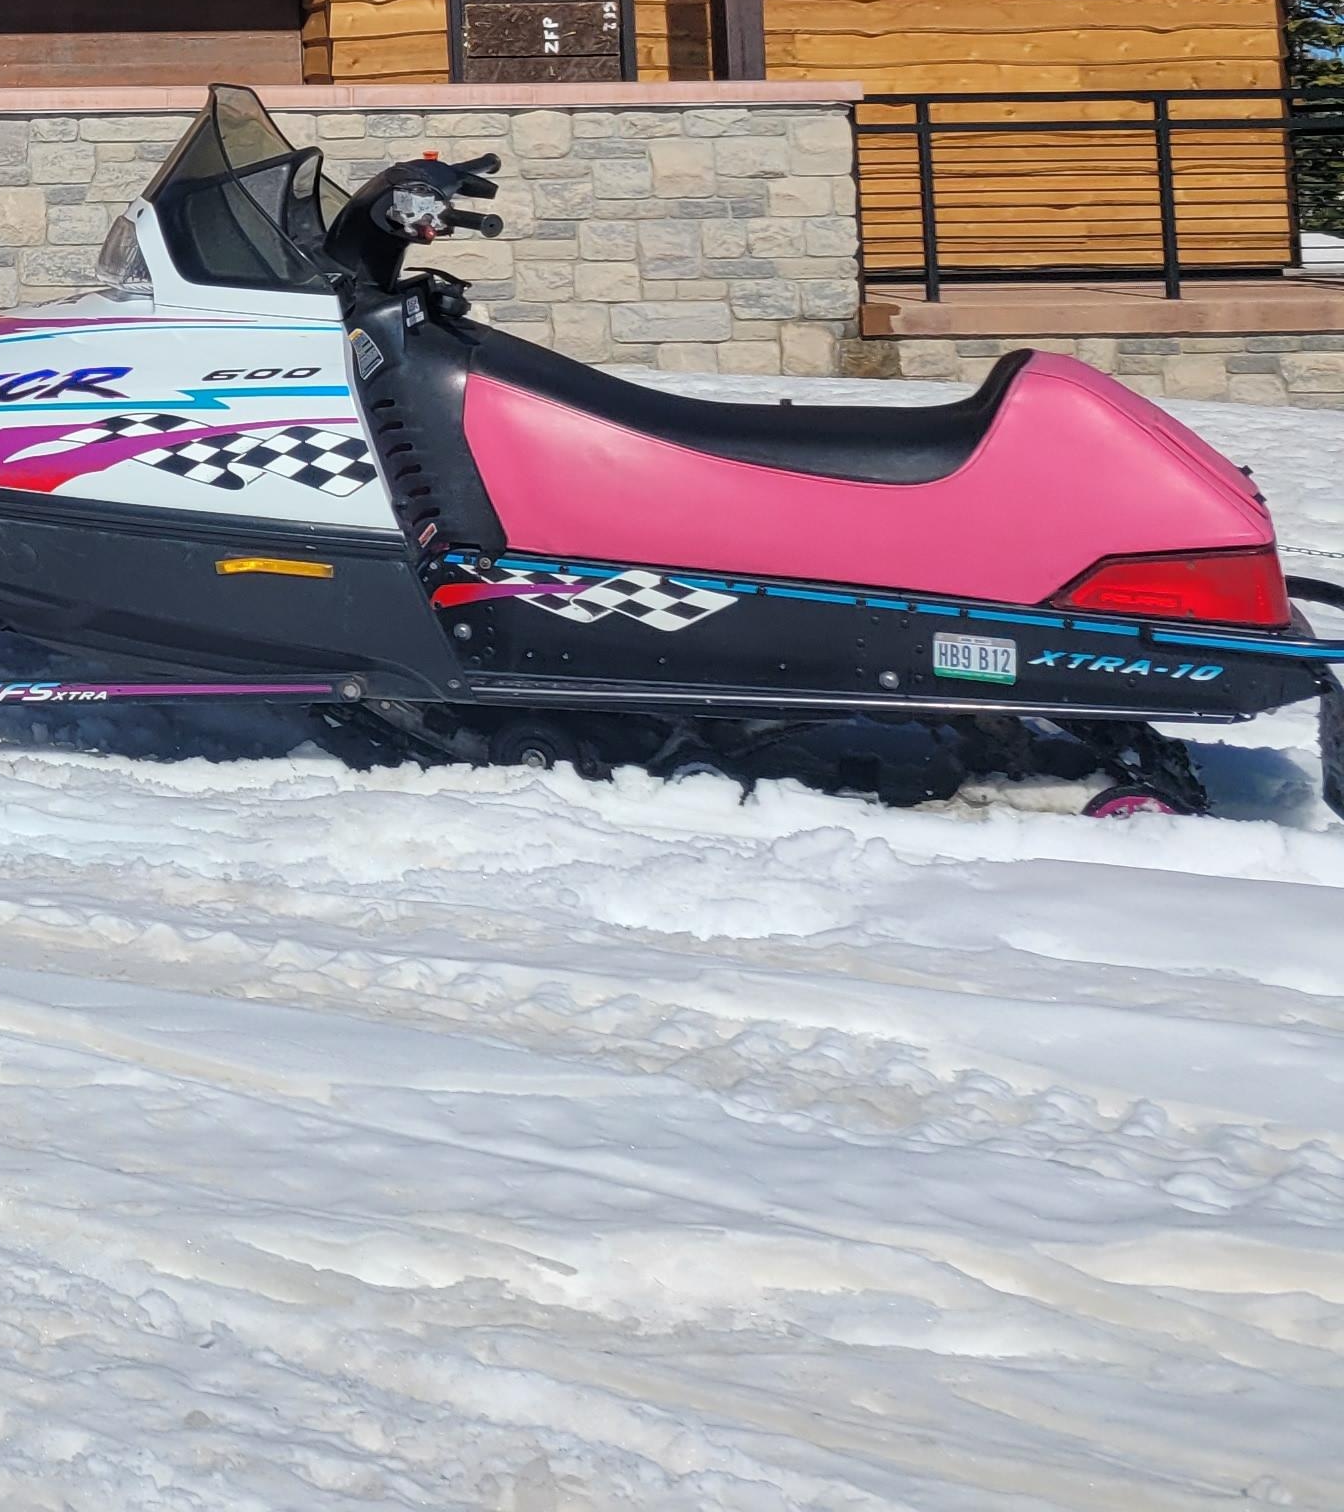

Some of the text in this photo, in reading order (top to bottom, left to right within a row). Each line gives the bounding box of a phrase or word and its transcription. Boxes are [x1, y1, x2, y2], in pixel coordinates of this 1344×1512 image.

[202, 367, 321, 382] 600
[938, 642, 1011, 674] HB9 B12
[1026, 649, 1225, 682] XTRA-10
[50, 690, 108, 702] XTRA
